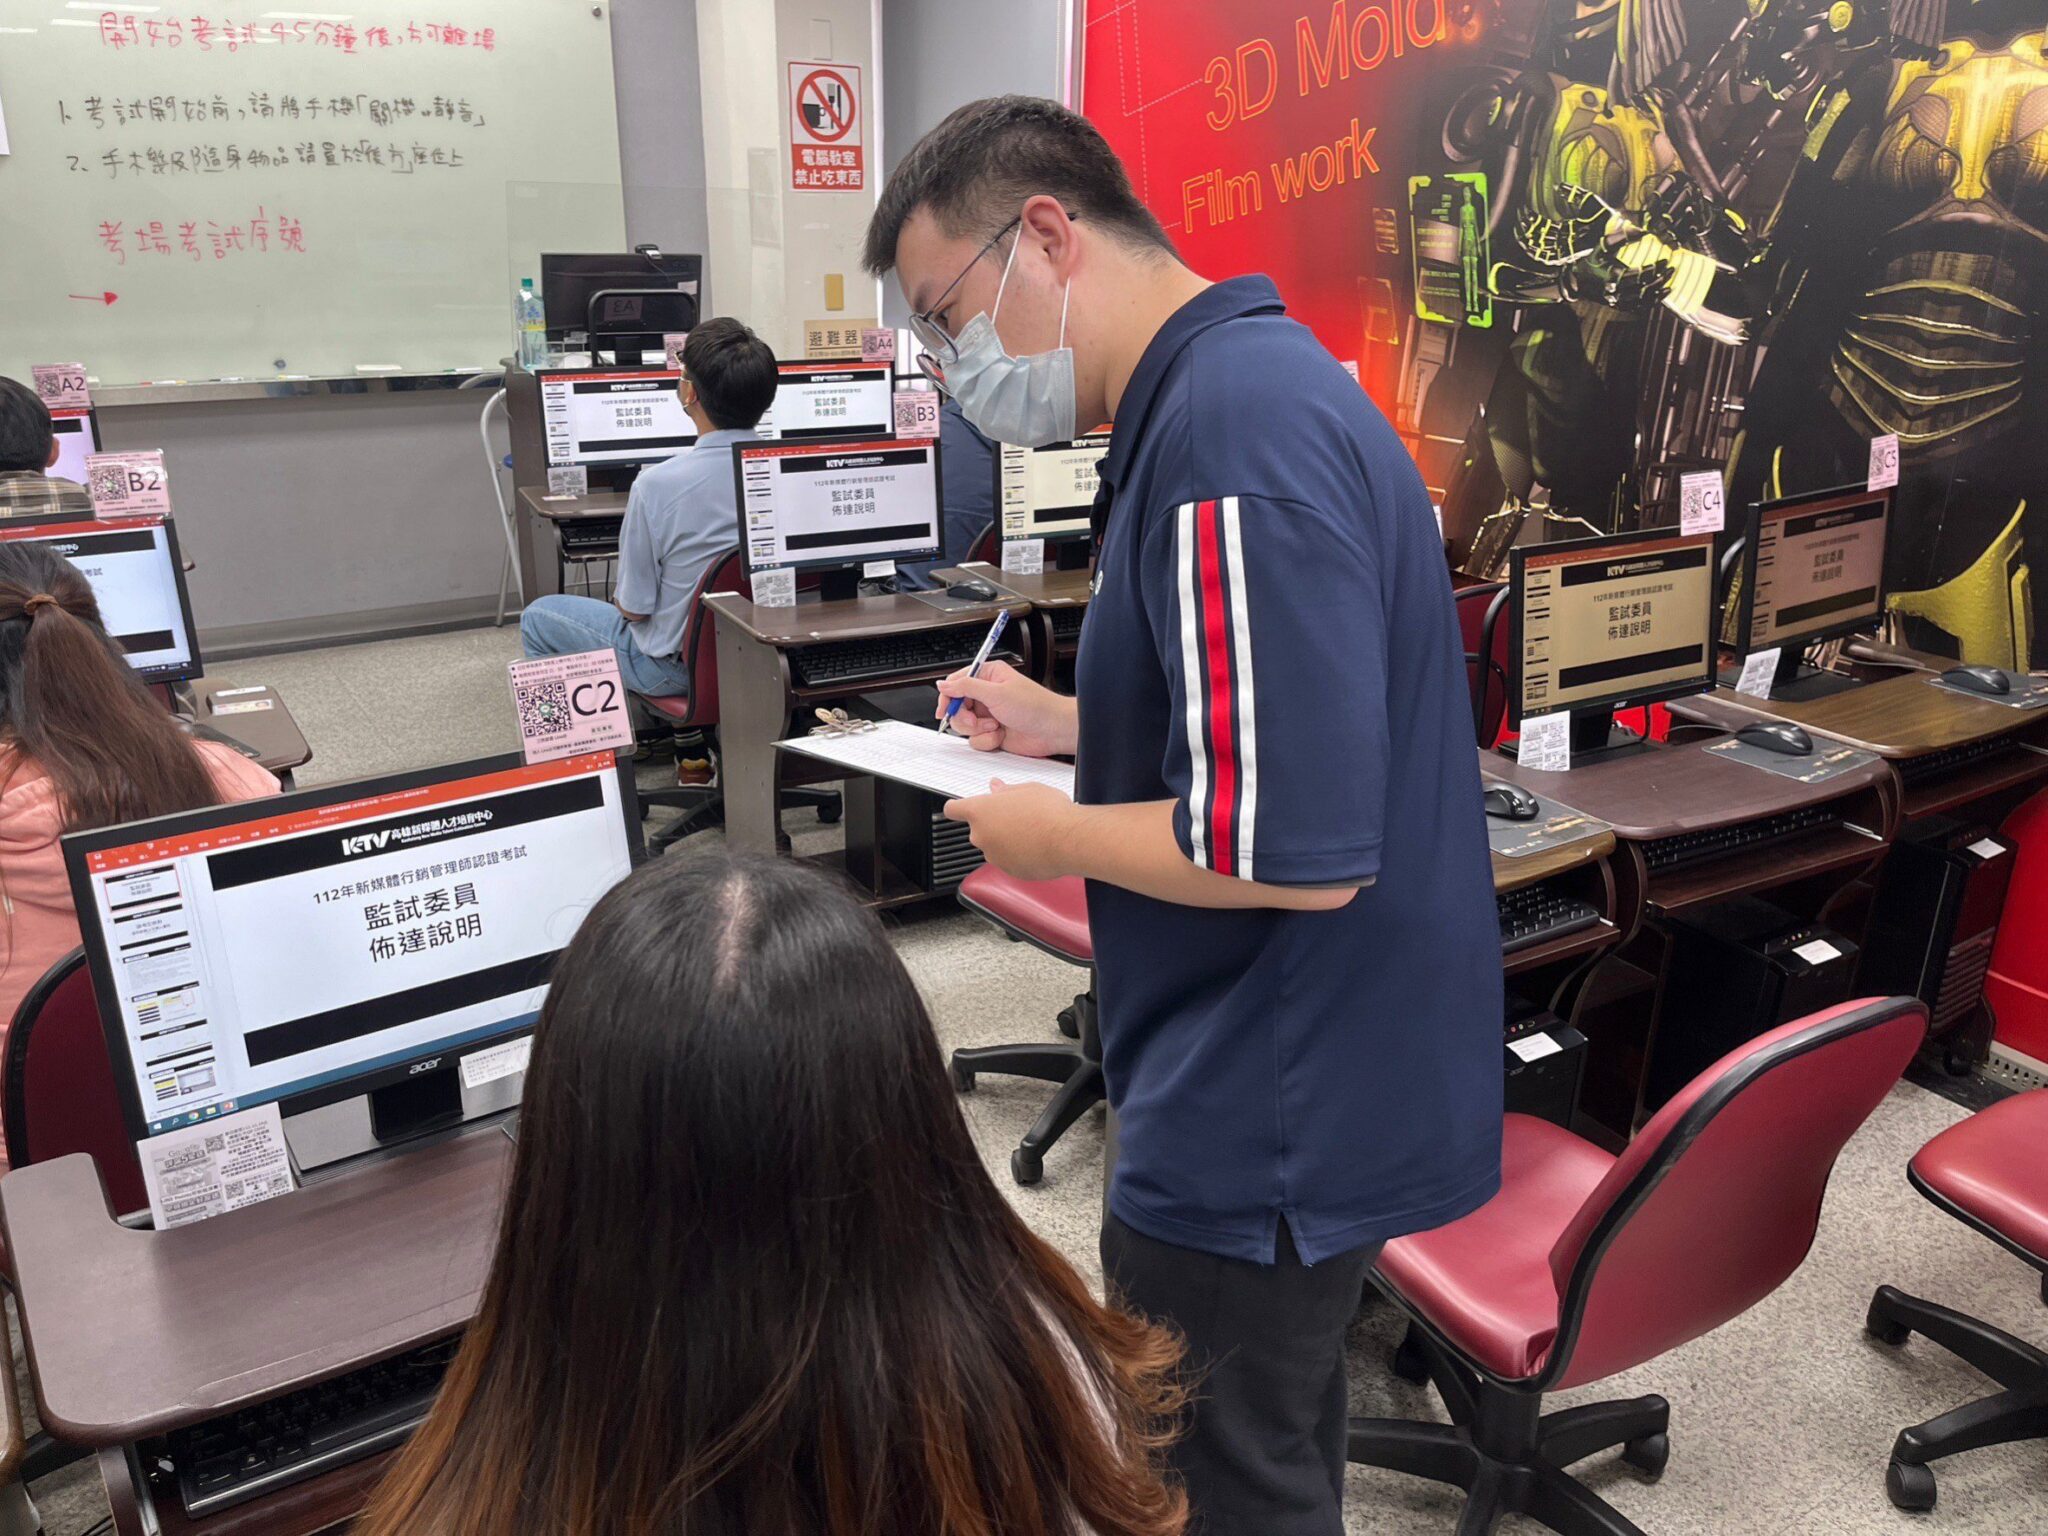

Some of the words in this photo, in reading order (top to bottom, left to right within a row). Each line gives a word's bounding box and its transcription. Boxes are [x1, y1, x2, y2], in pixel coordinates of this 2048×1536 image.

[1205, 38, 1278, 131] 3D
[801, 149, 856, 167] 電腦教室
[795, 169, 862, 186] 禁止吃東西
[1182, 169, 1262, 234] Film
[1271, 118, 1381, 203] work
[99, 206, 306, 265] 考場考試序號
[878, 338, 893, 350] A4
[62, 377, 85, 392] A2
[917, 406, 936, 422] B3
[128, 471, 162, 492] B2
[1703, 490, 1721, 511] C4
[571, 680, 620, 717] C2
[342, 830, 391, 856] KTV
[313, 845, 528, 904] 112年新媒體行銷管理師認證考試
[364, 882, 480, 931] 監試委員
[369, 912, 483, 963] 佈達說明
[408, 1058, 442, 1075] acer
